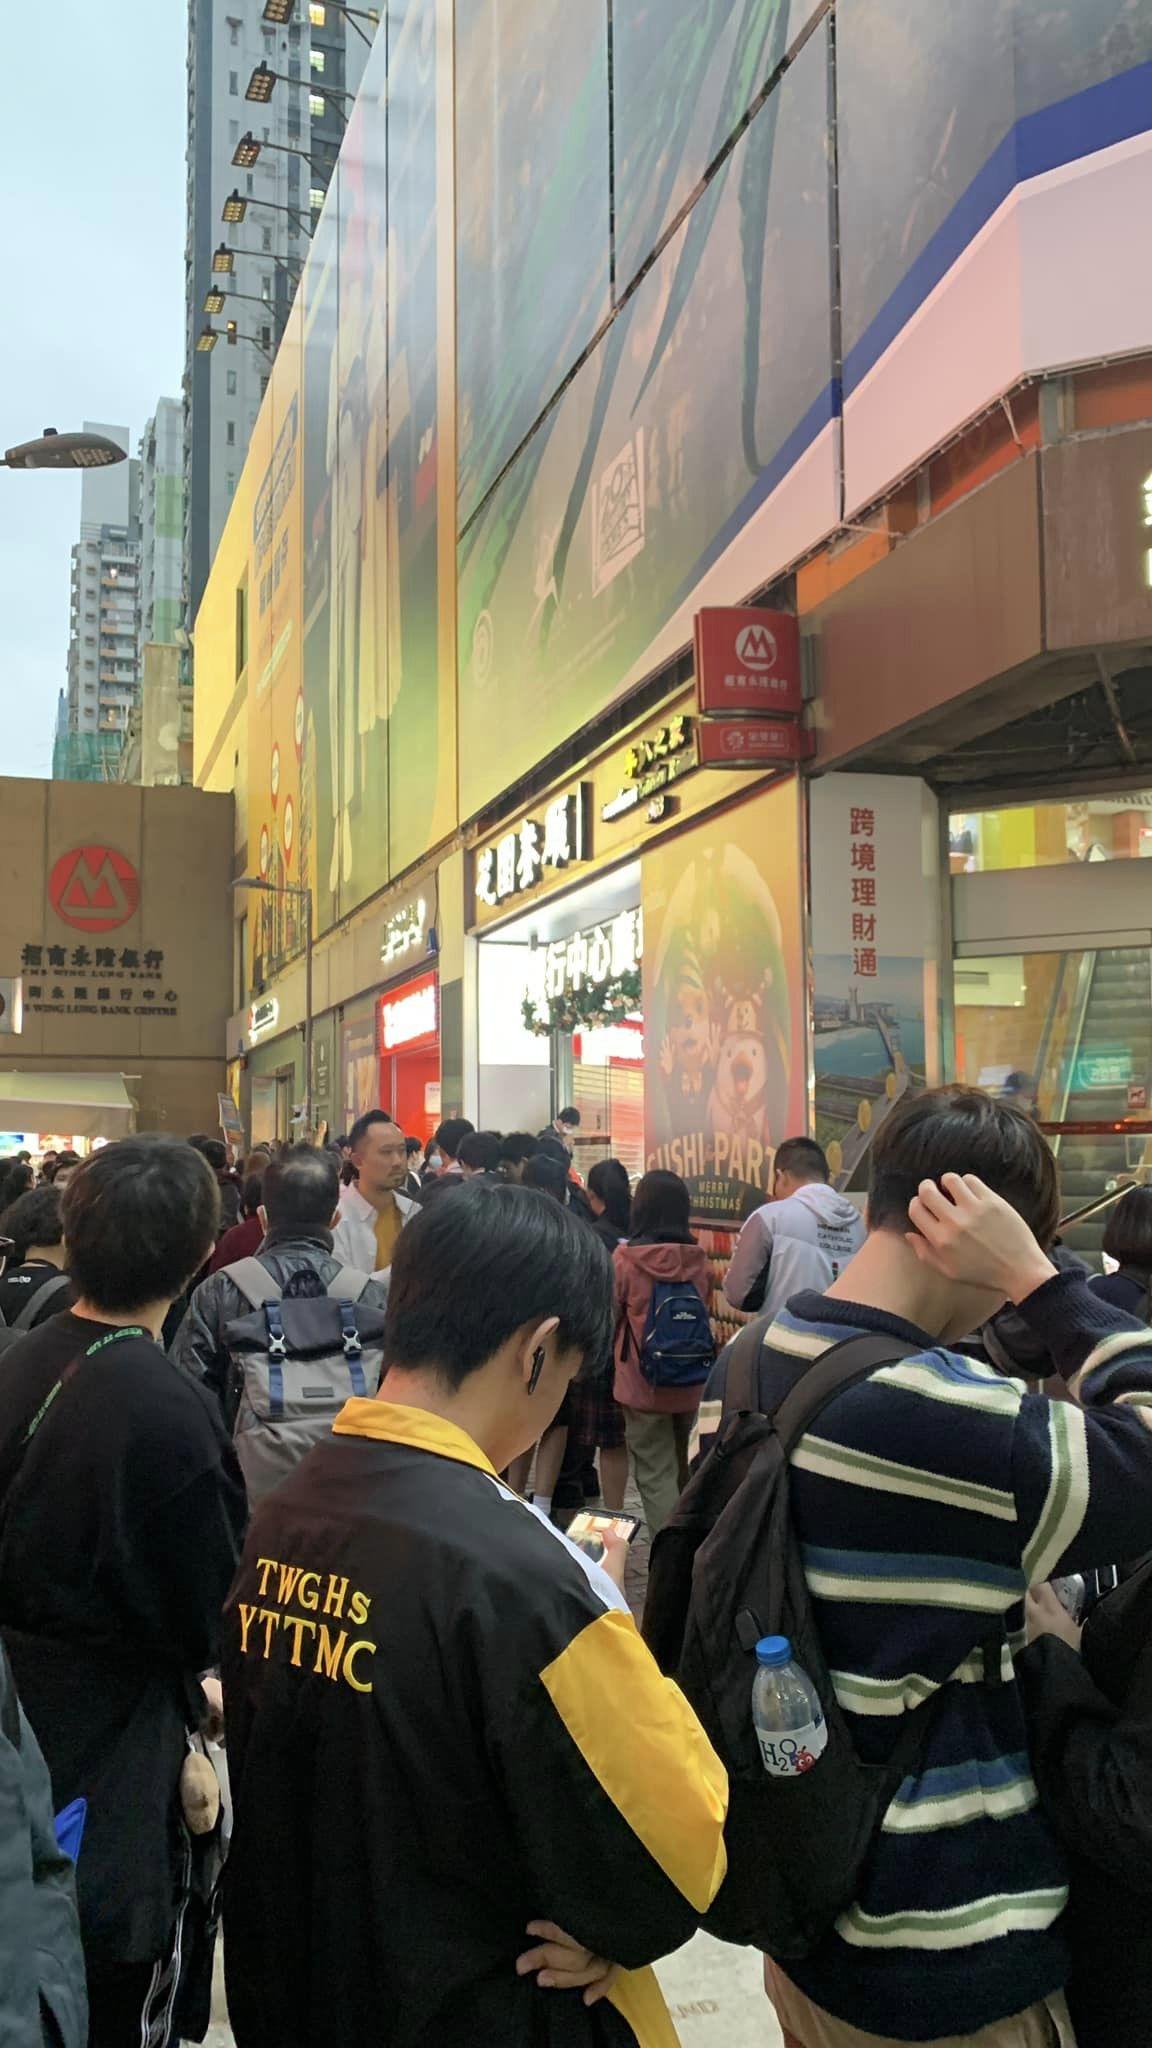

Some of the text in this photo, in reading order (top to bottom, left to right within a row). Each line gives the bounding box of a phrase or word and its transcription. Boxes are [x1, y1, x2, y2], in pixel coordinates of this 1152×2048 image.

[850, 808, 877, 977] 跨境理財通
[33, 1004, 65, 1014] WING
[67, 1005, 98, 1015] LUNG
[101, 1006, 131, 1016] BANK
[134, 1006, 177, 1016] CENTRE
[698, 1181, 730, 1195] MERRY
[238, 1603, 377, 1693] YTTMC
